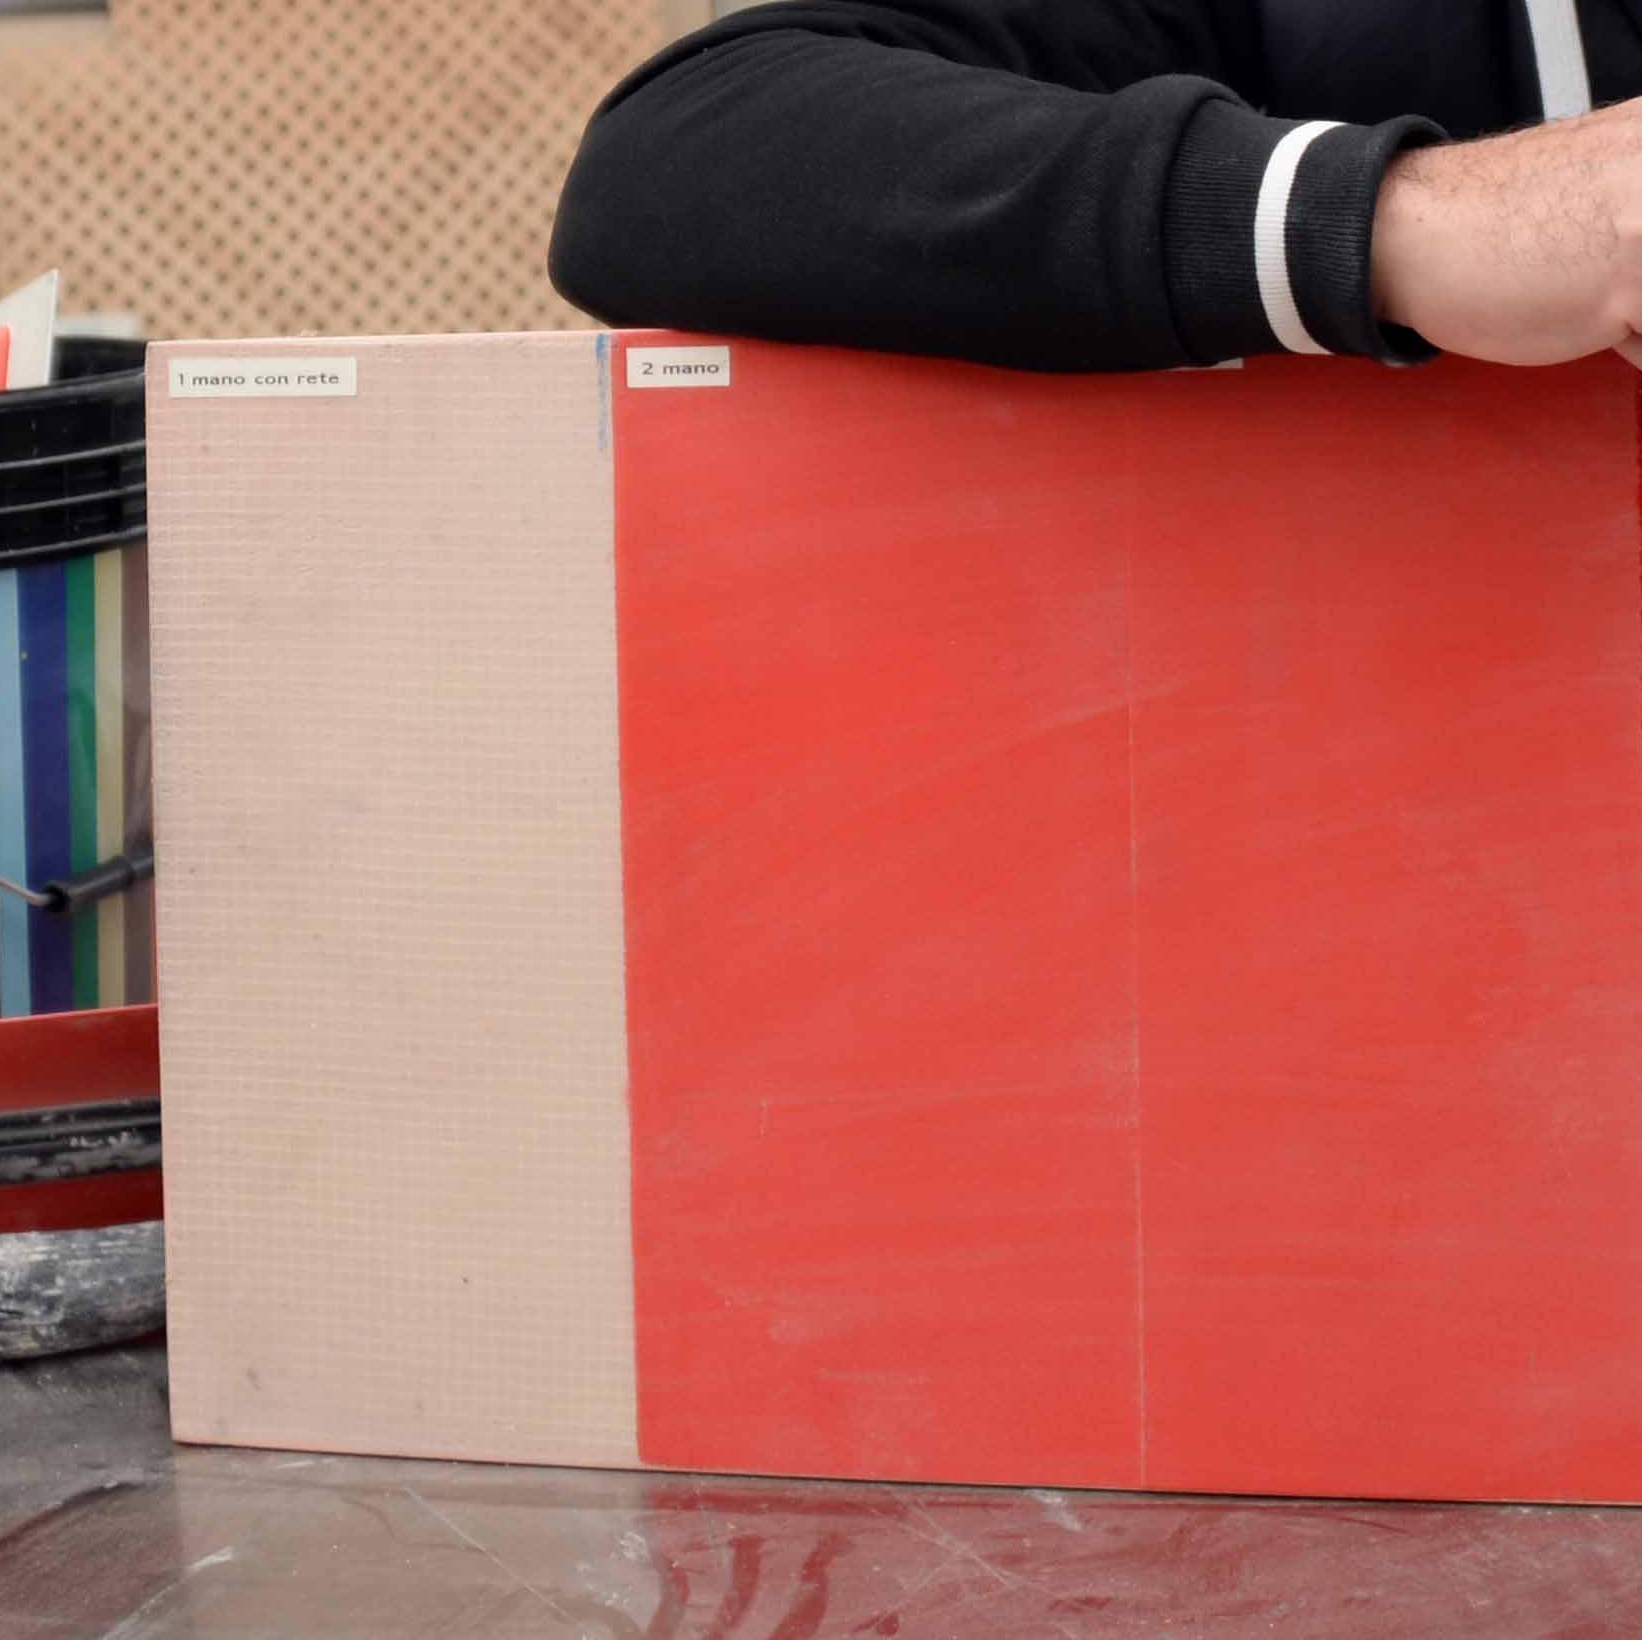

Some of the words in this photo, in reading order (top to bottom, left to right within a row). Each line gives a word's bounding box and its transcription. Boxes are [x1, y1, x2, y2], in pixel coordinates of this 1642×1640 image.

[642, 362, 654, 376] 2
[662, 363, 720, 375] mano
[177, 372, 185, 386] 1
[191, 374, 246, 386] mano
[253, 374, 289, 385] con
[296, 371, 341, 385] rete
